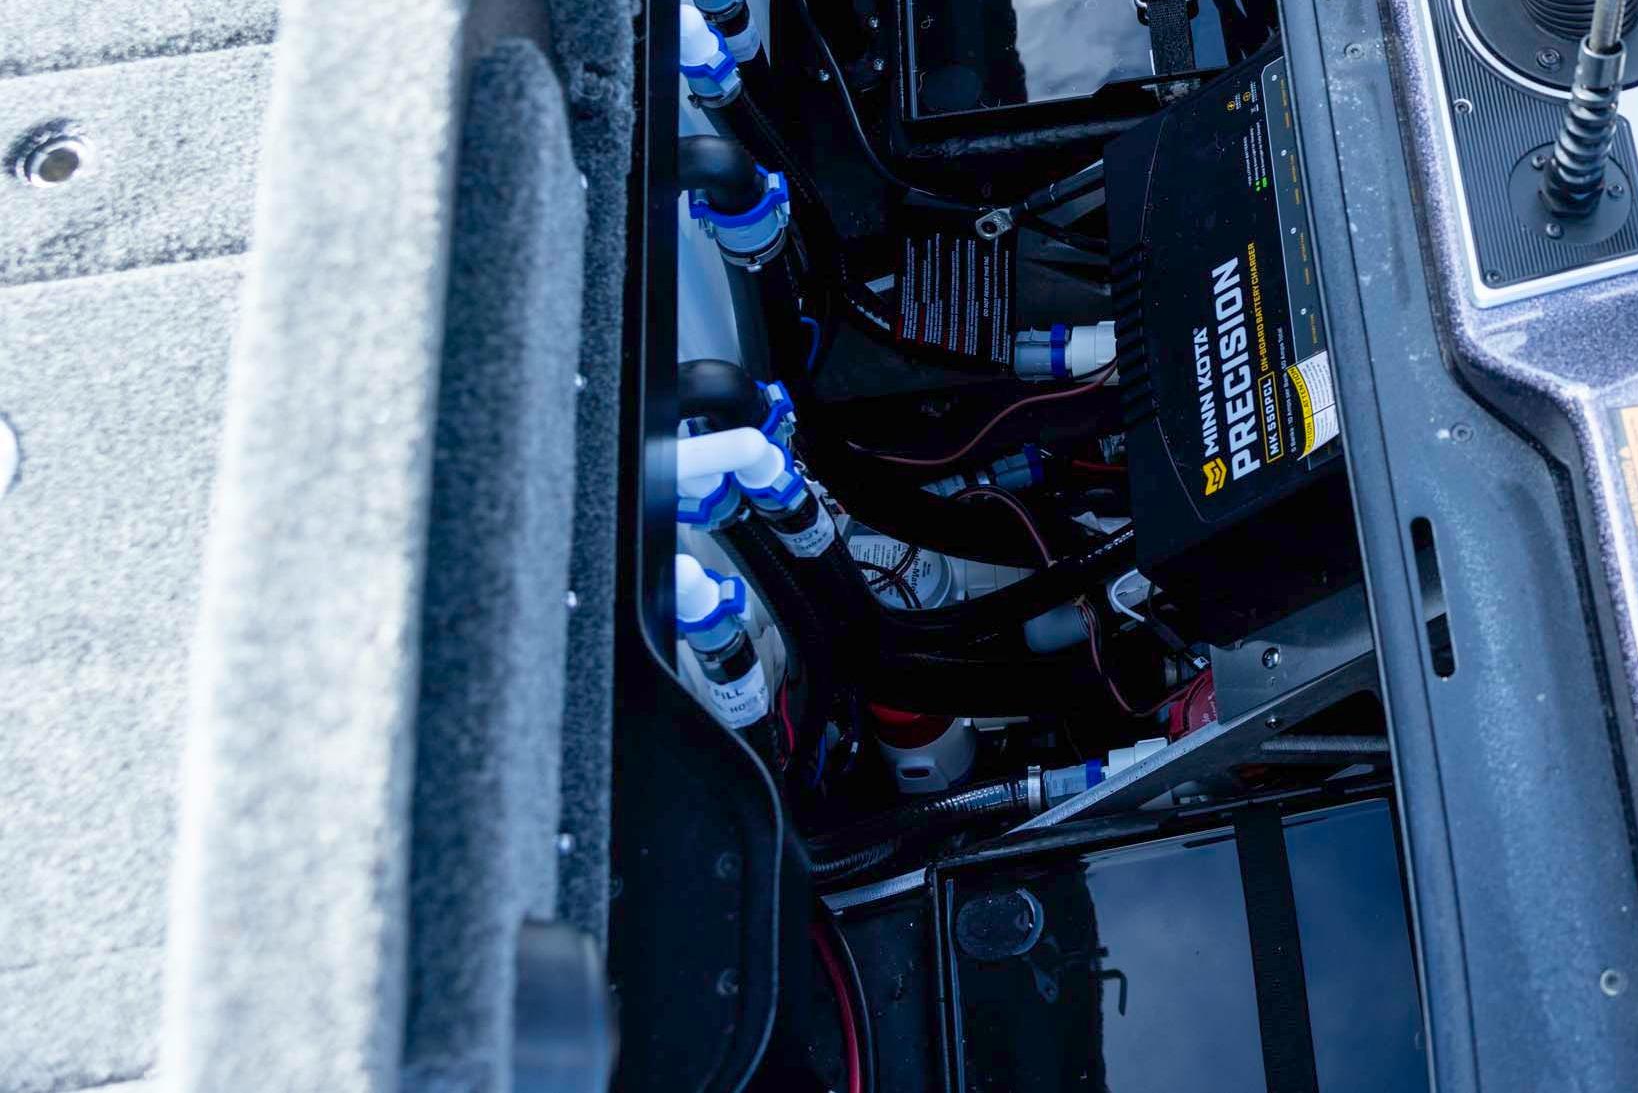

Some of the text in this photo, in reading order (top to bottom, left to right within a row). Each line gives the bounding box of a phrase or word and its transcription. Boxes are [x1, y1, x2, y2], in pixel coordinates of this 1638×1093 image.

[1247, 242, 1269, 371] ON-BOARD BATTERY CHARGER
[1211, 257, 1261, 481] PRECISION
[1289, 366, 1310, 408] ATTENTION
[1199, 391, 1220, 457] MINN
[1262, 378, 1281, 456] MK 550PCL
